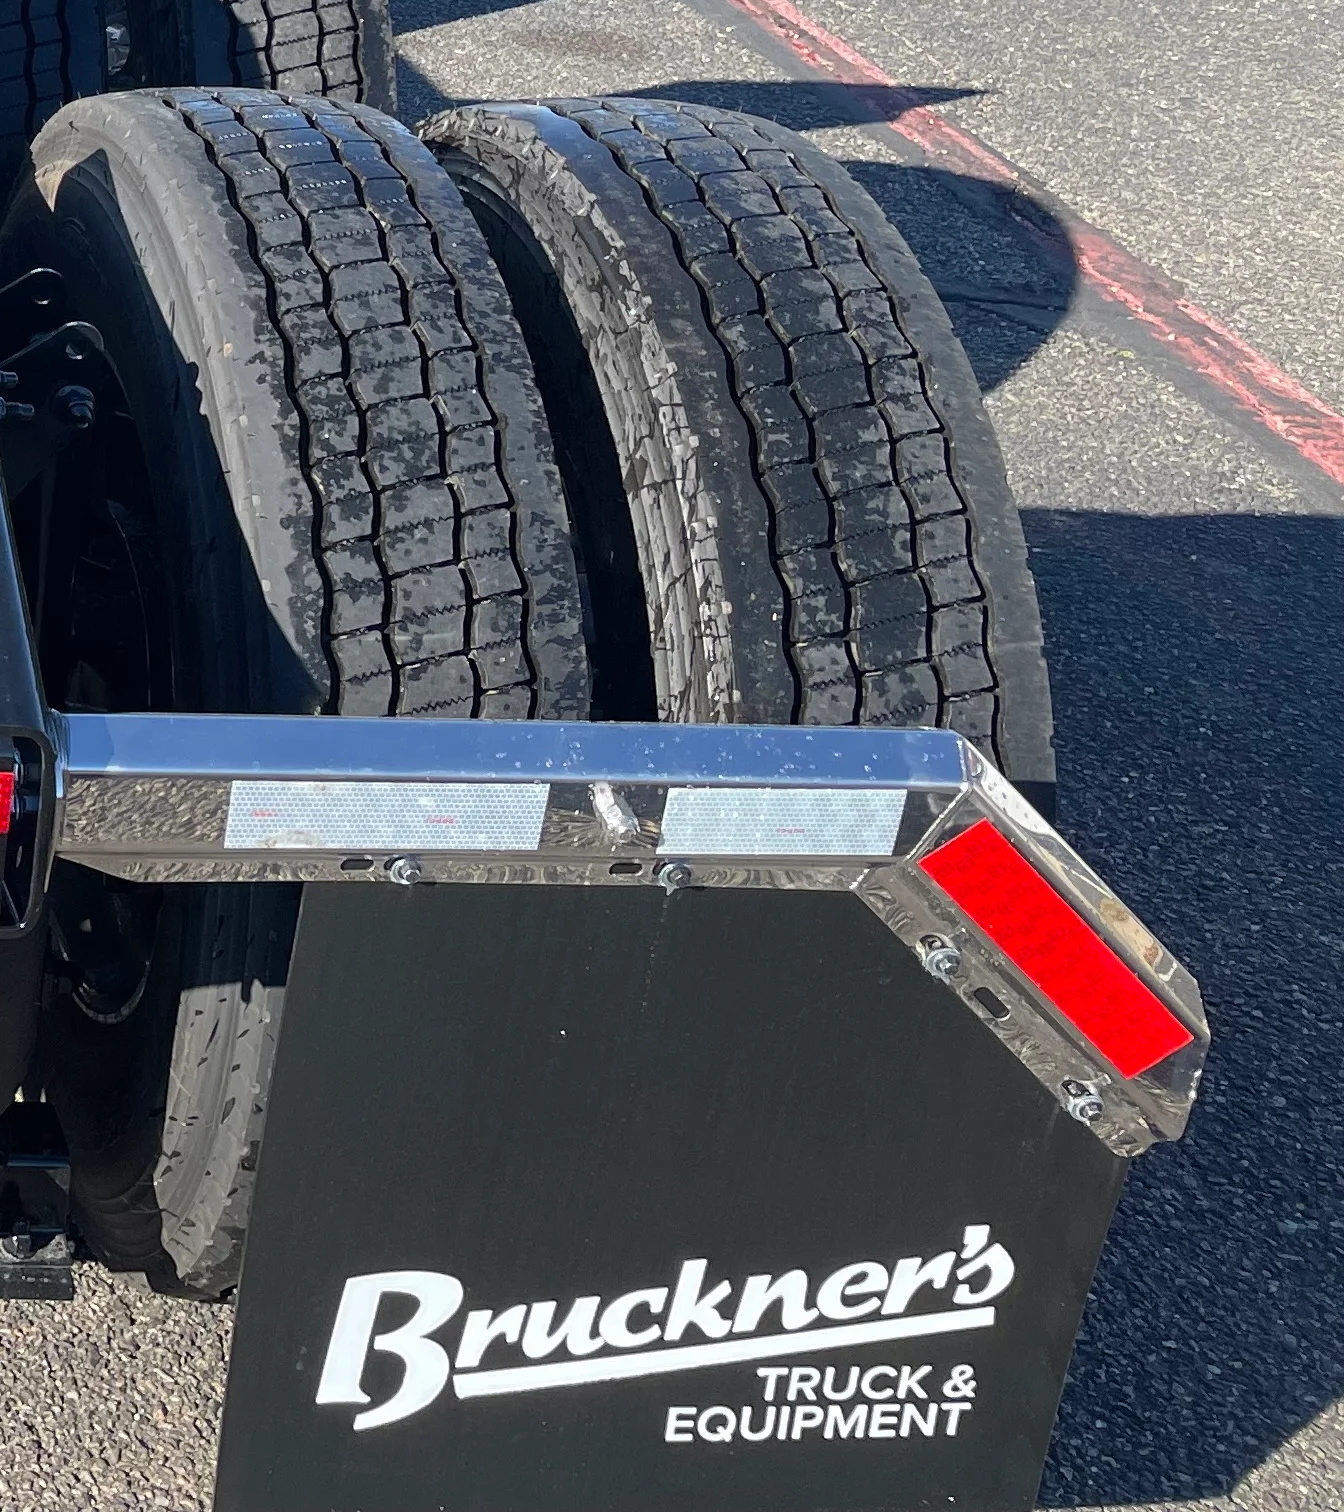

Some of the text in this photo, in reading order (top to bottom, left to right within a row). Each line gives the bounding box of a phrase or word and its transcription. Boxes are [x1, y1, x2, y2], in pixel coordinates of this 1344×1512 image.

[314, 1223, 1016, 1432] Bruckner's
[755, 1364, 978, 1403] TRUCK &
[663, 1402, 973, 1444] EQUIPMENT
